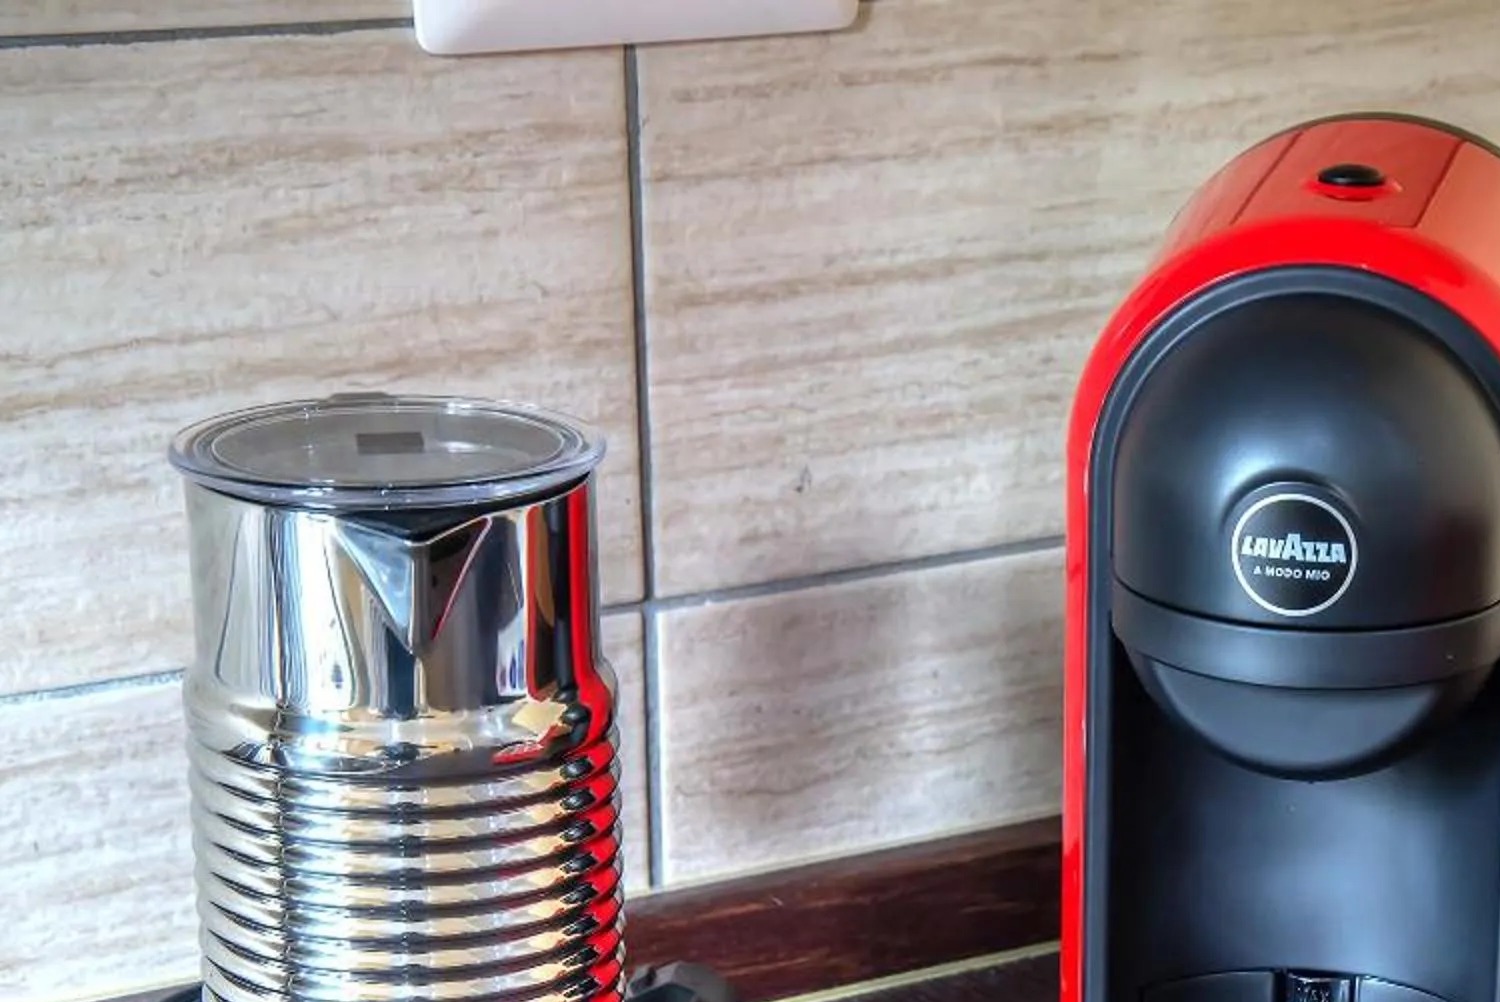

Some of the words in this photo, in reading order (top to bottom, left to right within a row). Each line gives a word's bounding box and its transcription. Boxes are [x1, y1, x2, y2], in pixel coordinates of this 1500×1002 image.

[1241, 533, 1347, 563] LAVAZZA
[1264, 565, 1302, 579] MODO
[1305, 569, 1331, 581] MIO
